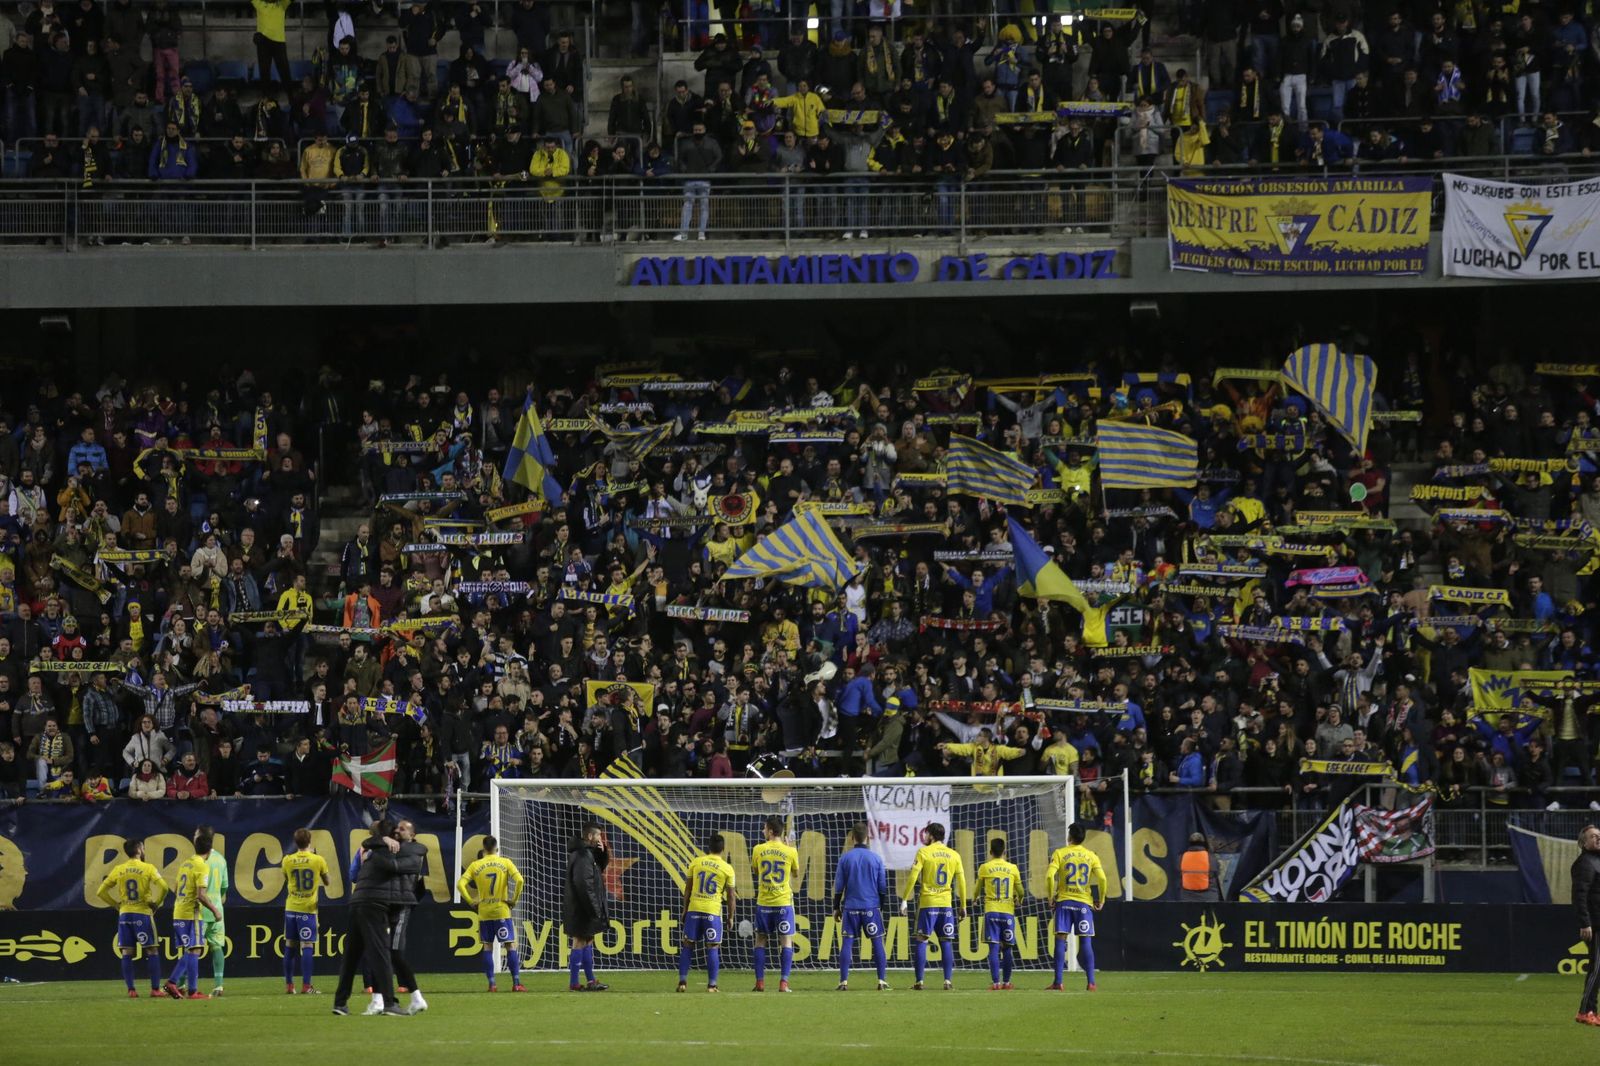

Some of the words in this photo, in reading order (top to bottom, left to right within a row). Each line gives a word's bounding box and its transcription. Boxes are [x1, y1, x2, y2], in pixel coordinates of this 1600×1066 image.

[1332, 179, 1404, 193] AMARILLA
[1453, 181, 1468, 193] NO
[1520, 187, 1540, 198] CON
[1546, 186, 1572, 199] ESTE
[1327, 198, 1419, 235] CÁDIZ
[630, 252, 920, 287] AYUNTAMIENTO
[938, 253, 991, 282] DE
[1227, 257, 1251, 269] CON
[1253, 259, 1281, 271] ESTE
[1383, 259, 1408, 272] POR
[1409, 258, 1424, 271] EL
[1453, 248, 1522, 270] LUCHAD
[1540, 253, 1570, 271] POR
[740, 411, 767, 421] CADI
[1448, 588, 1484, 600] CADIZ
[264, 700, 310, 713] ANTIFA
[291, 869, 314, 891] 18
[761, 861, 785, 883] 25
[936, 863, 948, 886] 6
[1064, 863, 1089, 886] 23
[126, 879, 139, 901] 8
[178, 874, 188, 897] 2
[486, 873, 497, 897] 7
[698, 871, 718, 896] 16
[992, 878, 1010, 899] 11
[1244, 919, 1271, 948] EL
[1275, 916, 1346, 949] TIMÓN
[1353, 922, 1383, 949] DE
[1388, 922, 1463, 951] ROCHE
[1244, 952, 1305, 964] RESTAURANTE
[1345, 953, 1372, 965] CONIL
[1373, 953, 1384, 965] DE
[1385, 954, 1396, 965] LA
